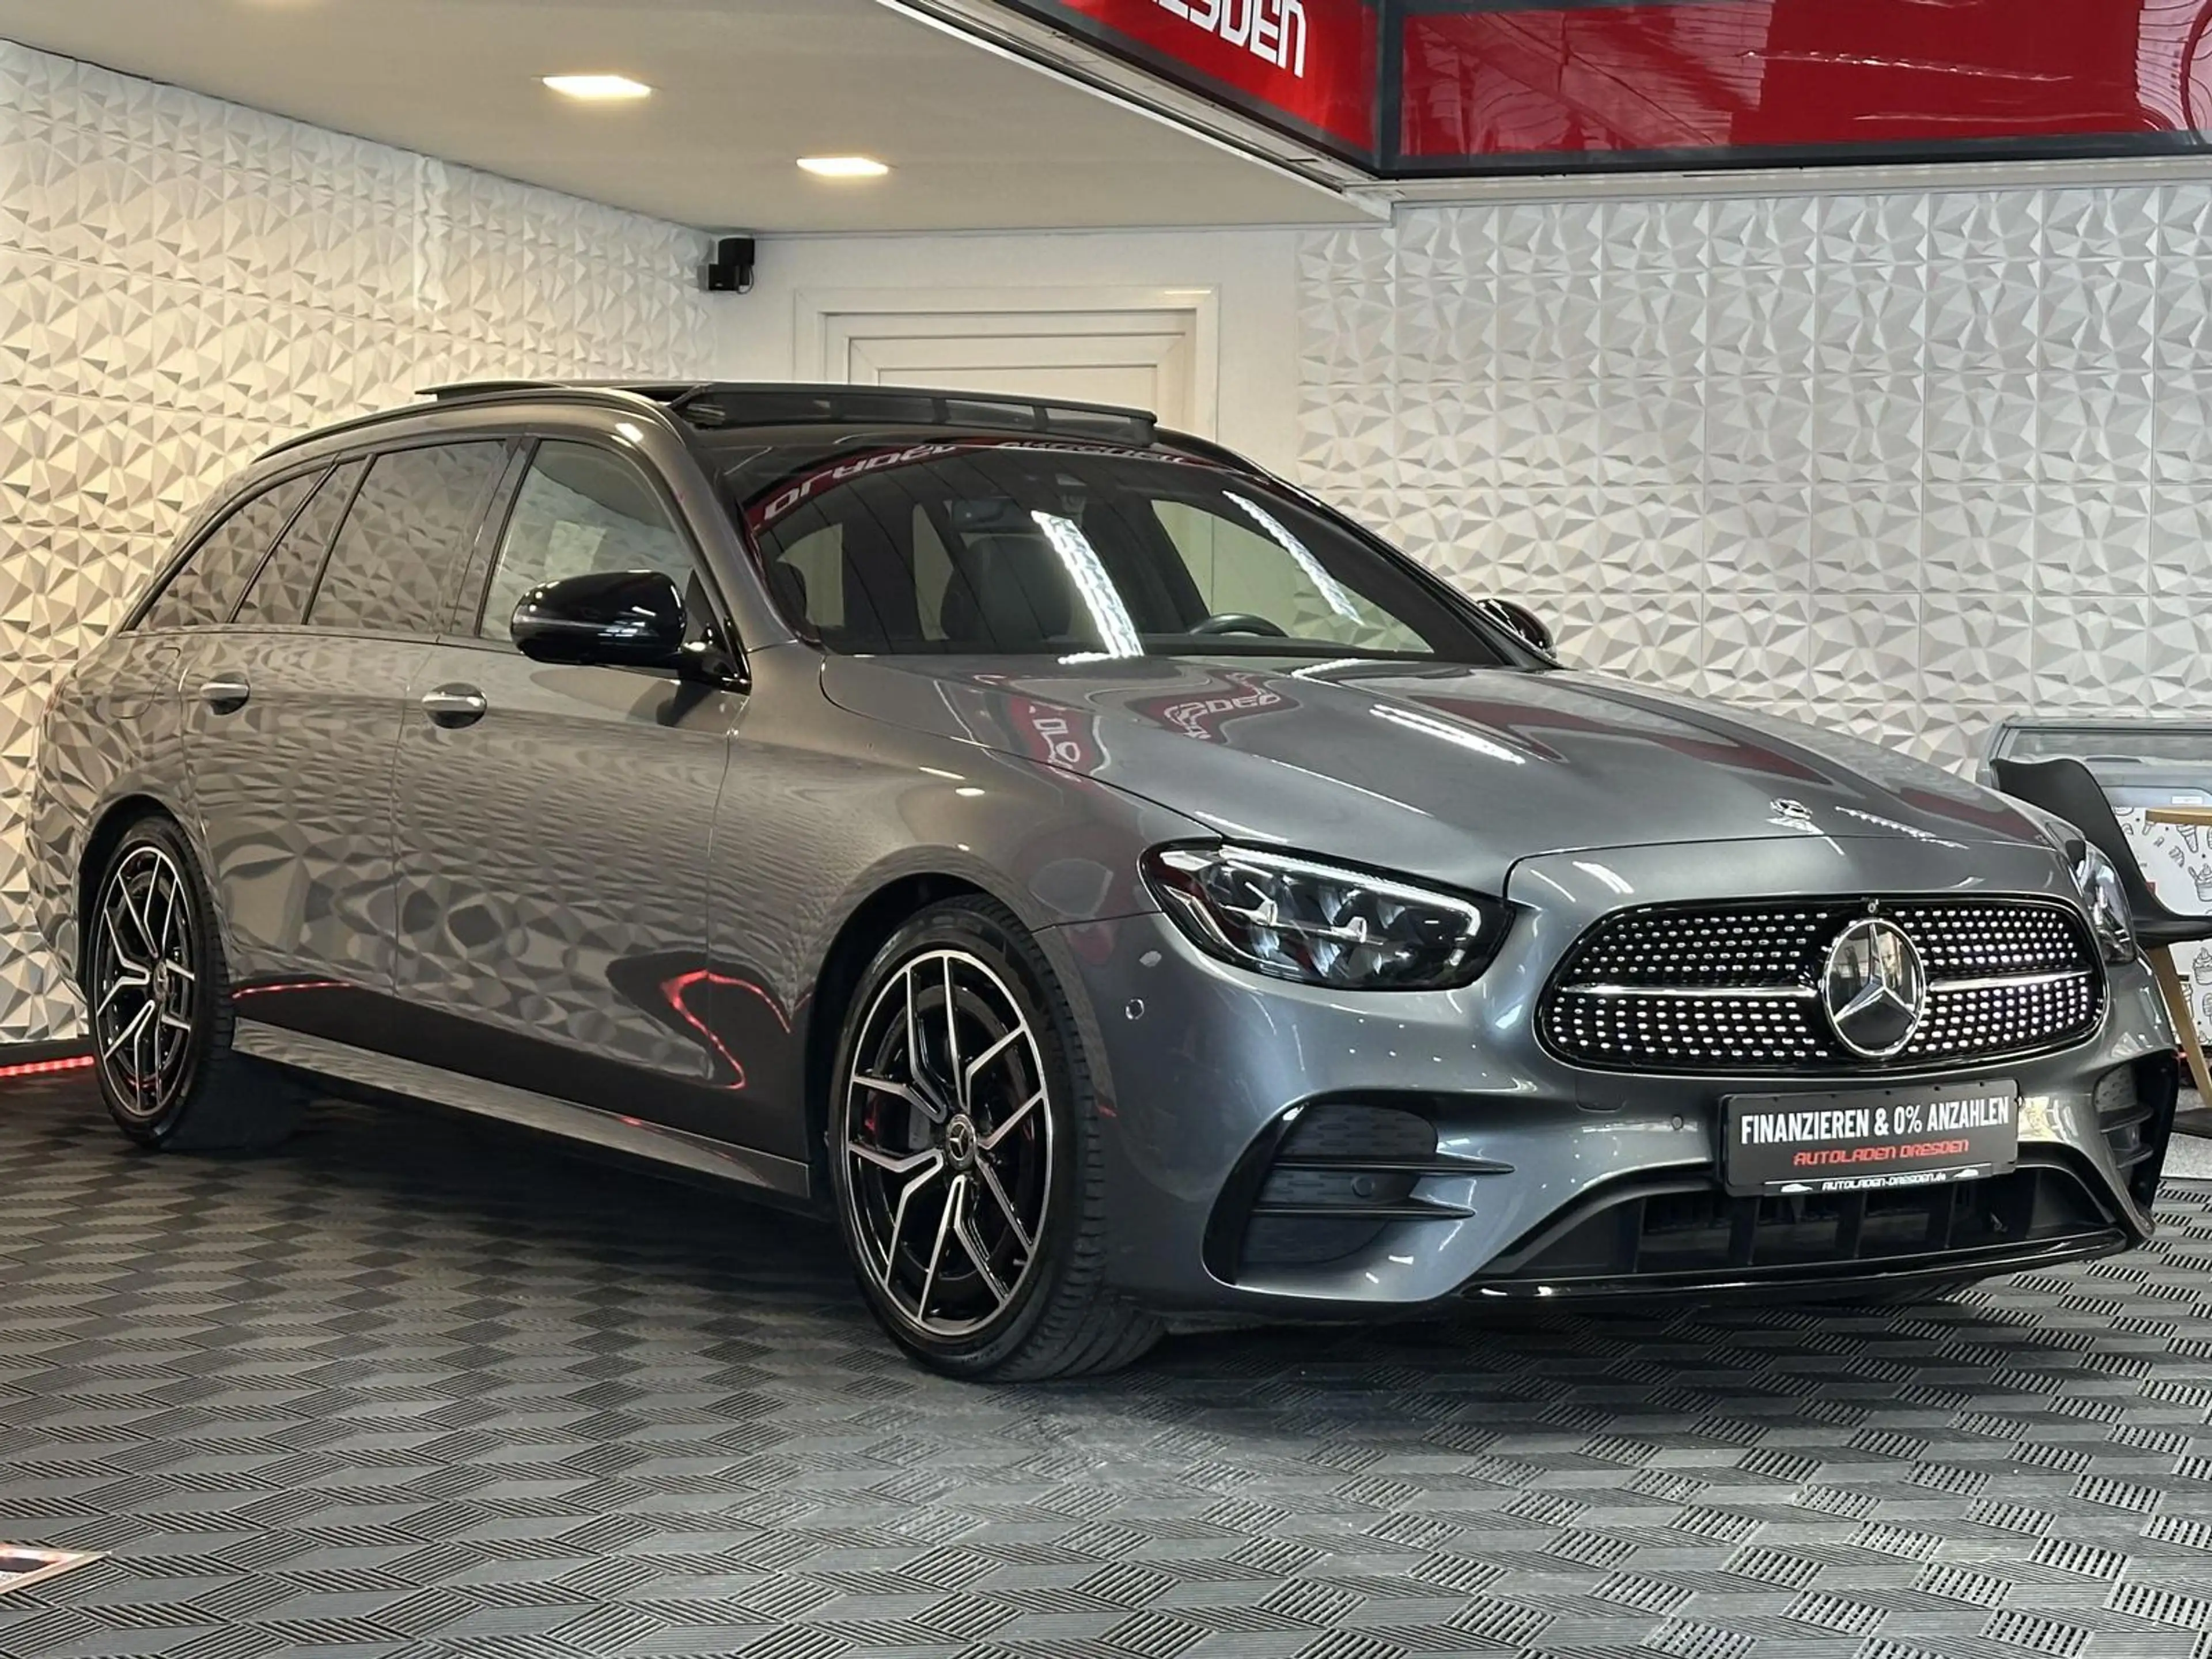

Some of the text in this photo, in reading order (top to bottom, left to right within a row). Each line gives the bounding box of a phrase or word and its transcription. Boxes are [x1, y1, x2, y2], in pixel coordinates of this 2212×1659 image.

[1154, 0, 1306, 78] SDEN
[1741, 1096, 2010, 1145] FINANZIEREN & 0% ANZAHLEN
[1793, 1139, 1969, 1166] AUTOLADEN DRESDEN
